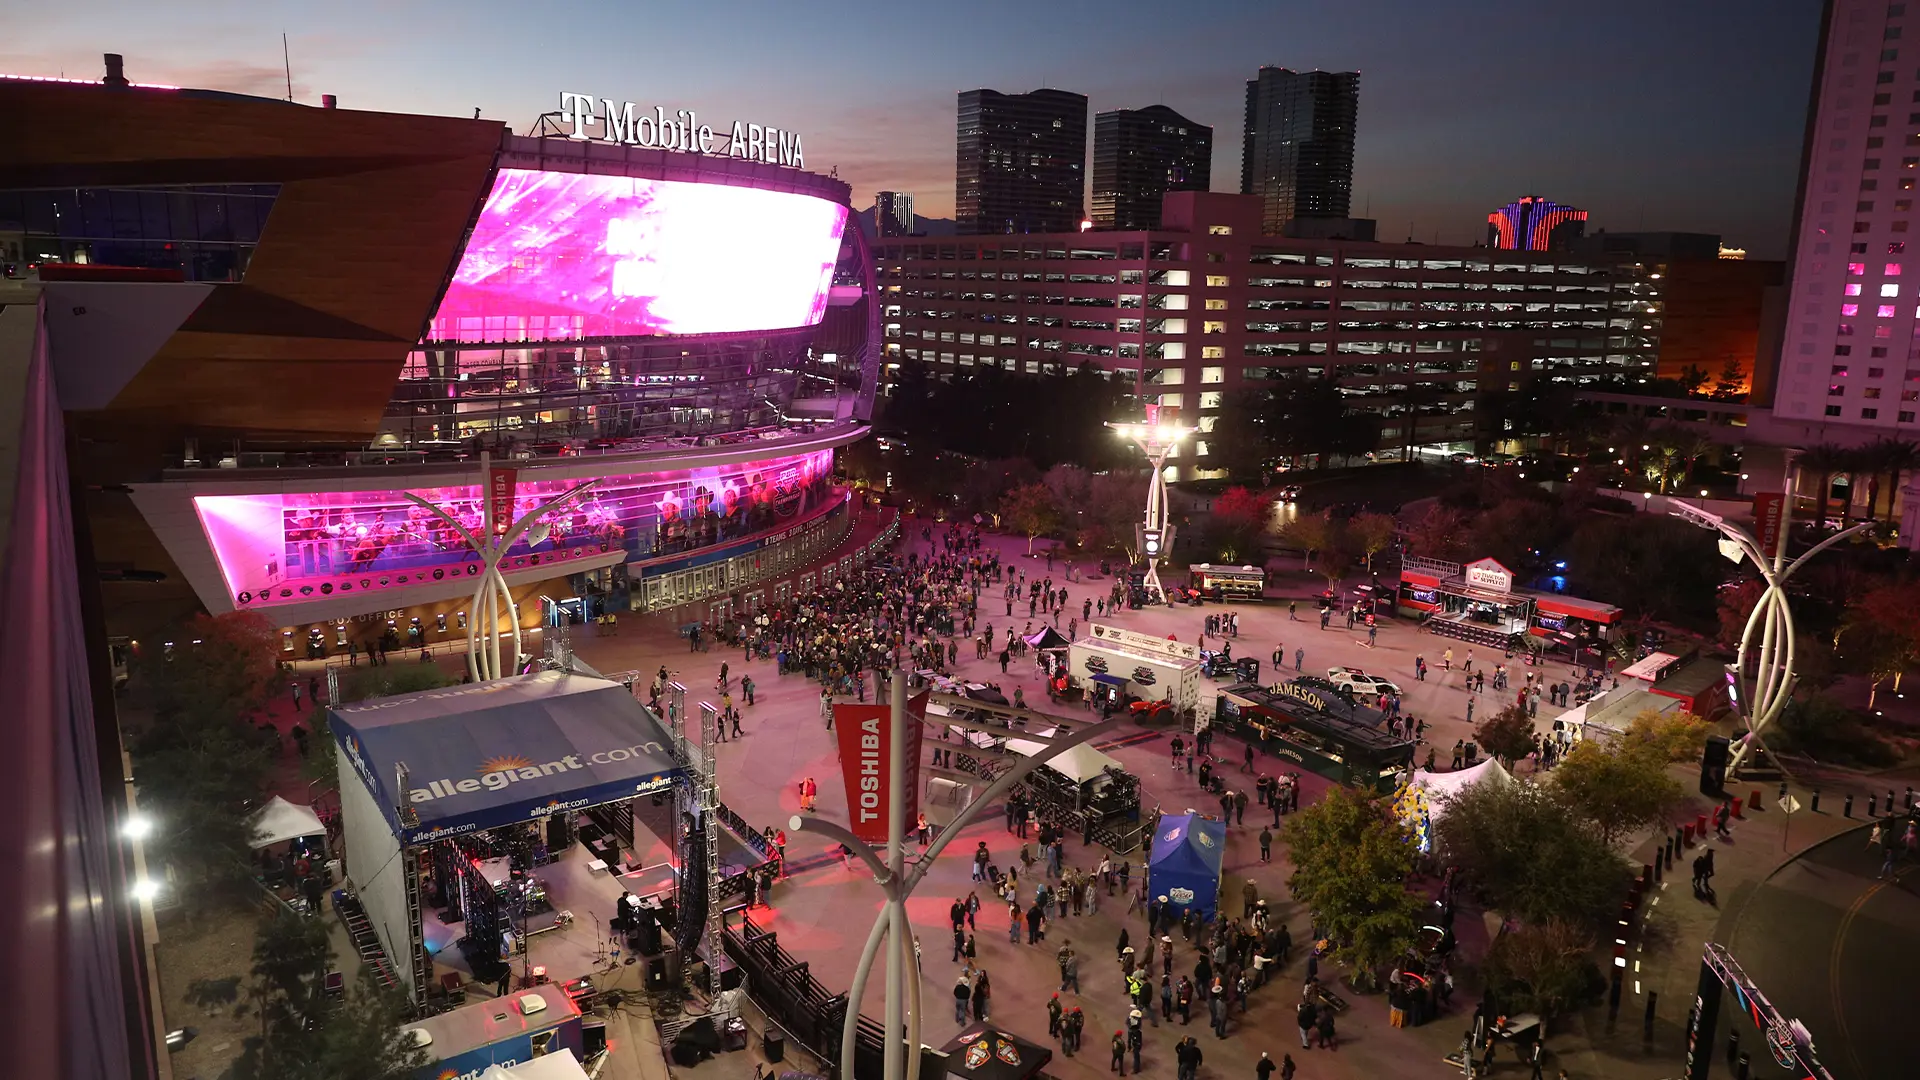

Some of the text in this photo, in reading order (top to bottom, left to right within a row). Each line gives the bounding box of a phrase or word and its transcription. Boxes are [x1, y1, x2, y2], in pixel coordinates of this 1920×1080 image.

[600, 98, 713, 154] Mobile
[729, 120, 804, 168] ARENA
[495, 474, 508, 533] TOSHIBA
[1762, 499, 1781, 550] TOSHIBA
[327, 608, 405, 627] BOX OFFICE
[1269, 682, 1324, 712] JAMESON
[410, 740, 664, 805] allegiant.com
[860, 717, 880, 824] TOSHIBA
[1278, 748, 1303, 763] JAMESON
[530, 798, 589, 817] allegiant.com
[412, 822, 476, 843] allegiant.com
